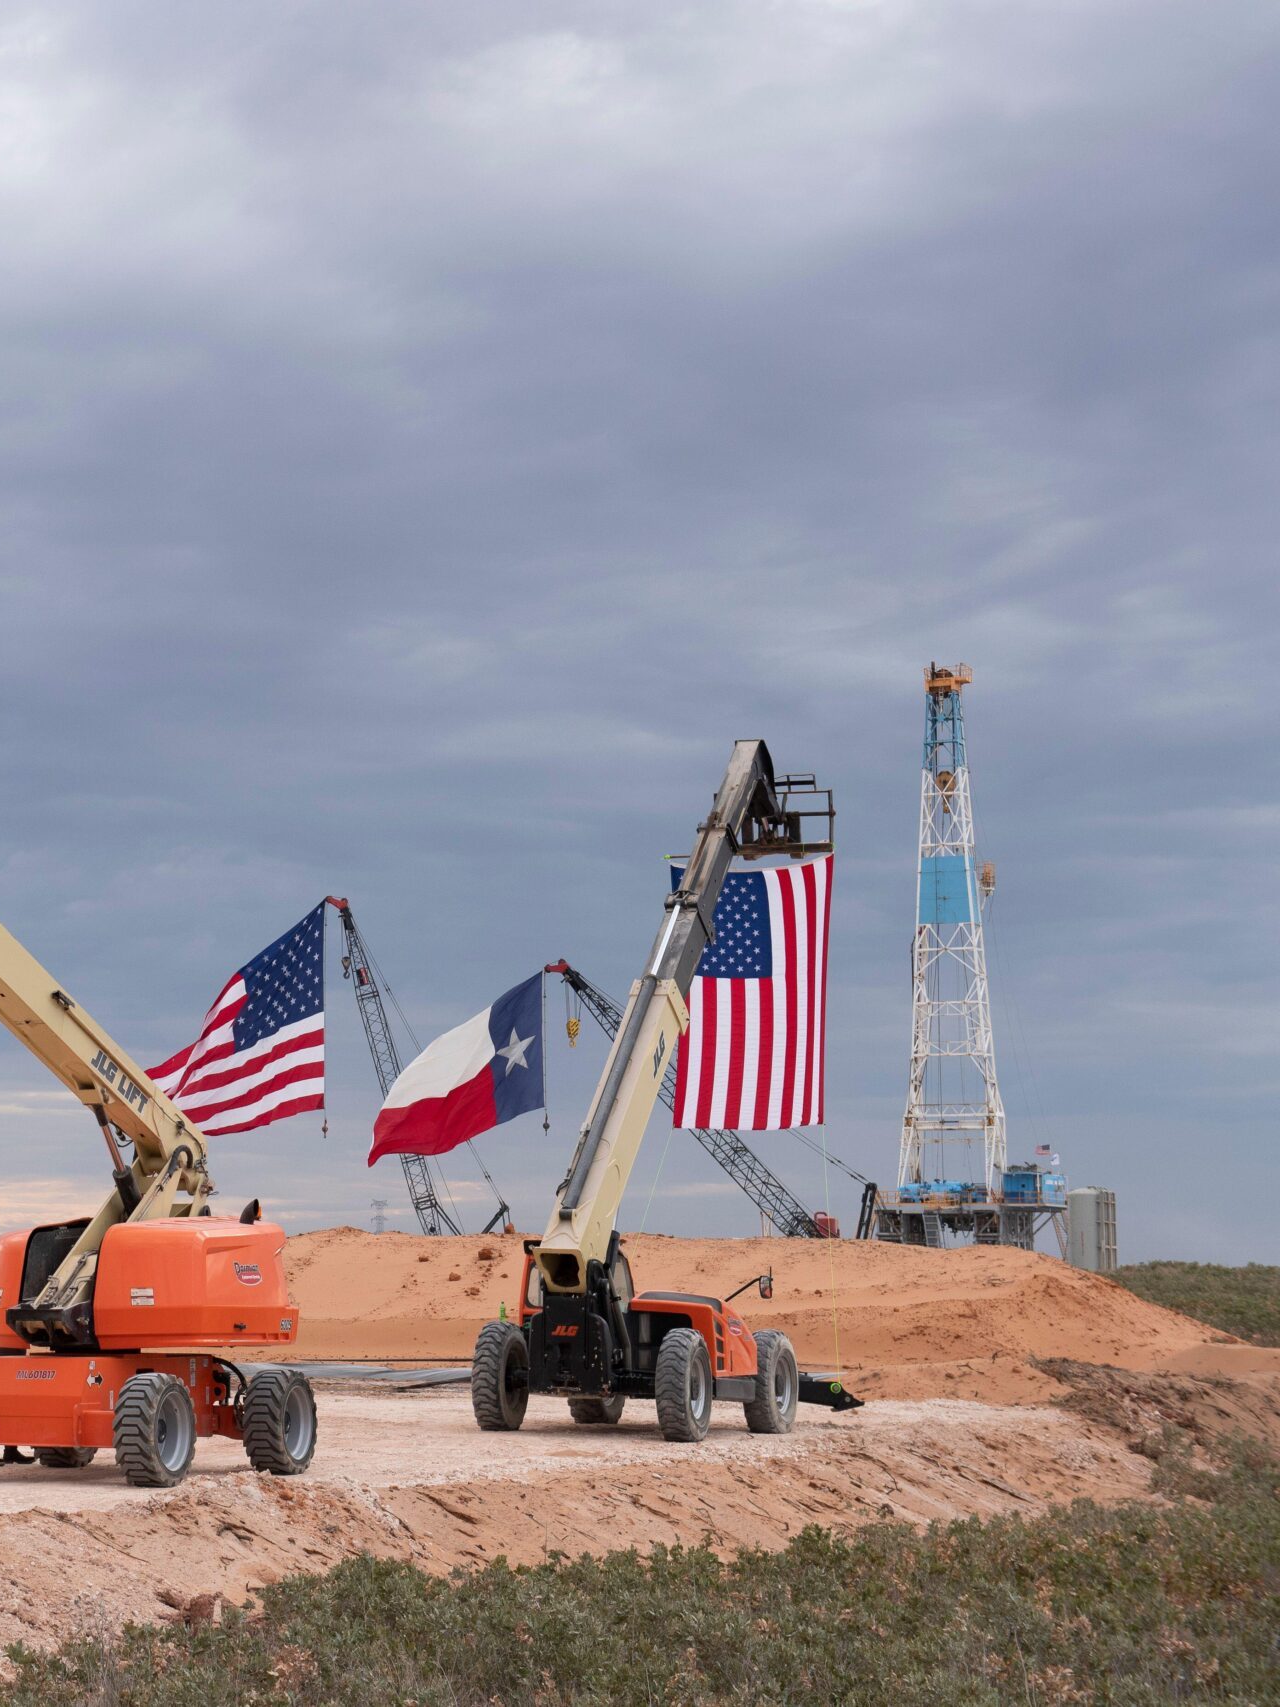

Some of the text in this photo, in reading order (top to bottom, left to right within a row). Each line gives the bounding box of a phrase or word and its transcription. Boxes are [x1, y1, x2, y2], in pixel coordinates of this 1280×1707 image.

[653, 1030, 665, 1079] JLG
[91, 1049, 148, 1113] JLG LIFT
[551, 1325, 577, 1337] JLG
